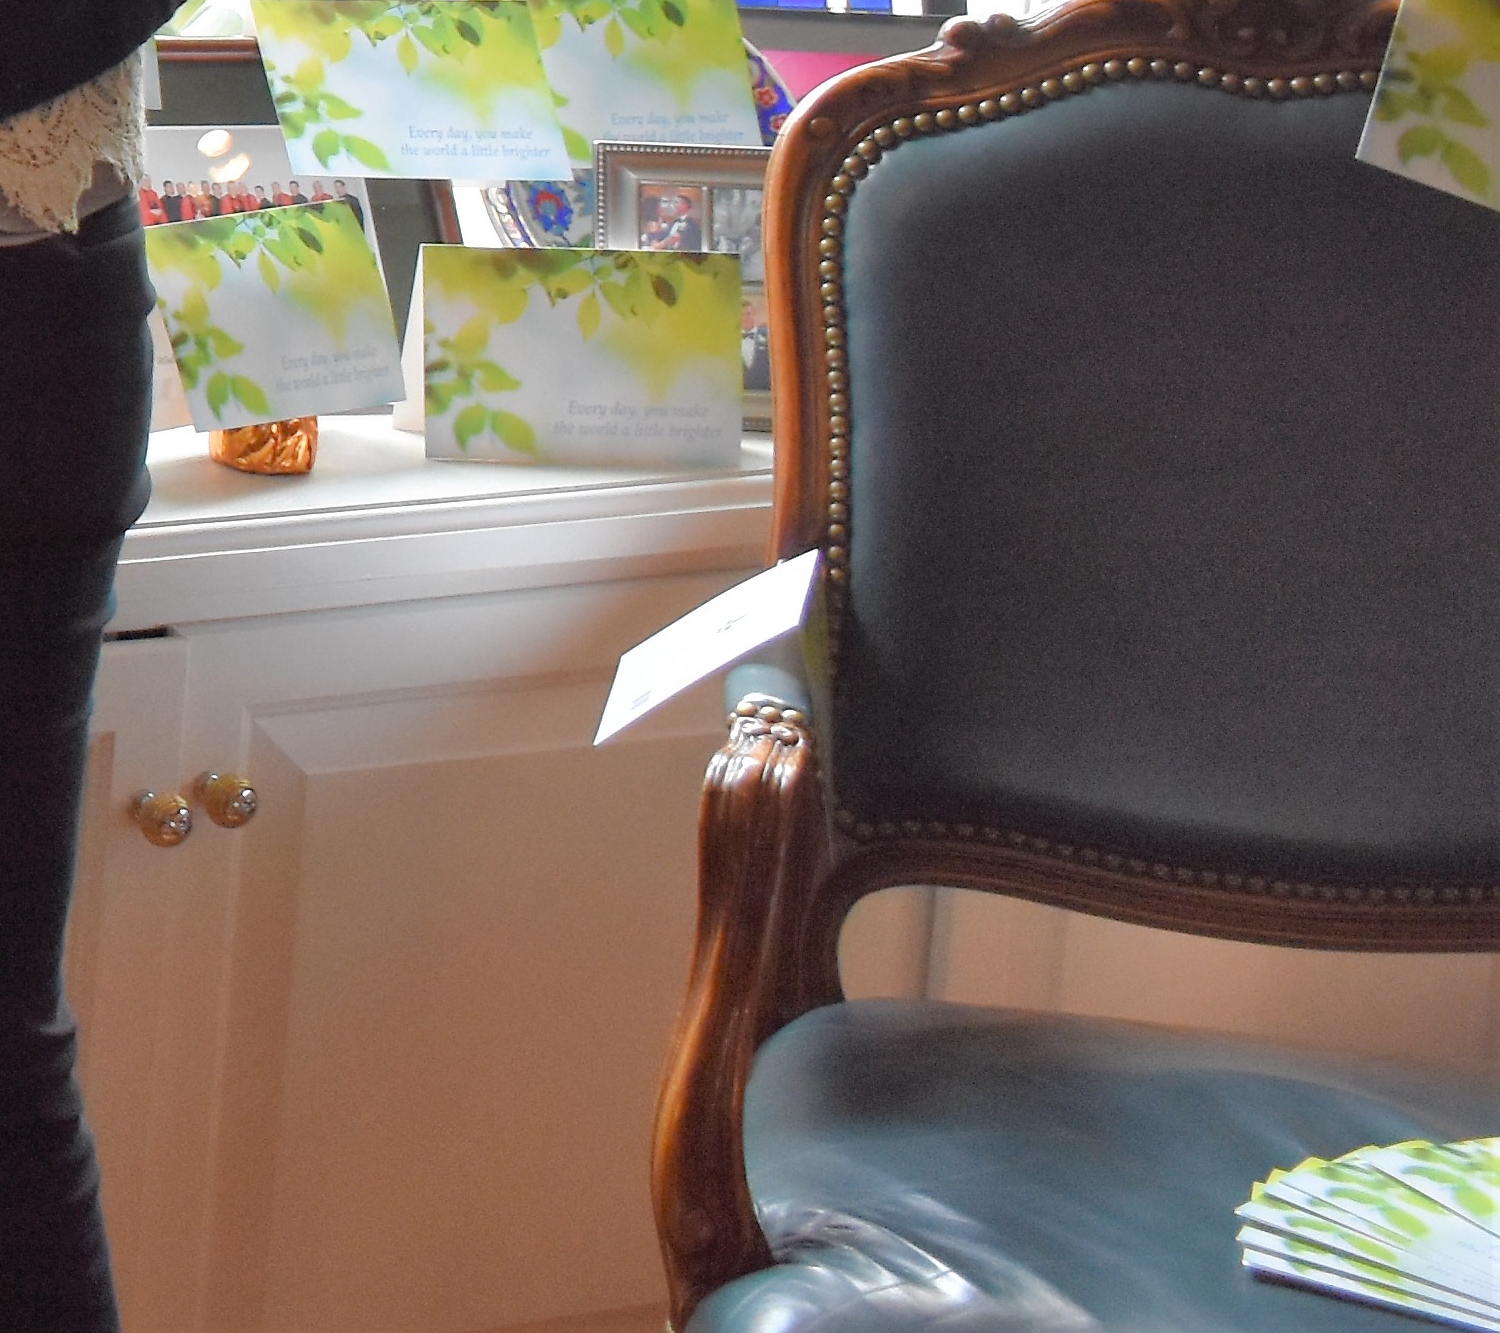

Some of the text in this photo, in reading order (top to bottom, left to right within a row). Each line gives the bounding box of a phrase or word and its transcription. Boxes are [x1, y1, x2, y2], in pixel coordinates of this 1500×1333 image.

[408, 125, 442, 142] Every
[476, 130, 496, 142] you
[501, 125, 532, 139] make
[400, 143, 418, 155] the
[423, 143, 457, 156] world
[471, 144, 498, 157] little
[502, 145, 550, 162] brighter
